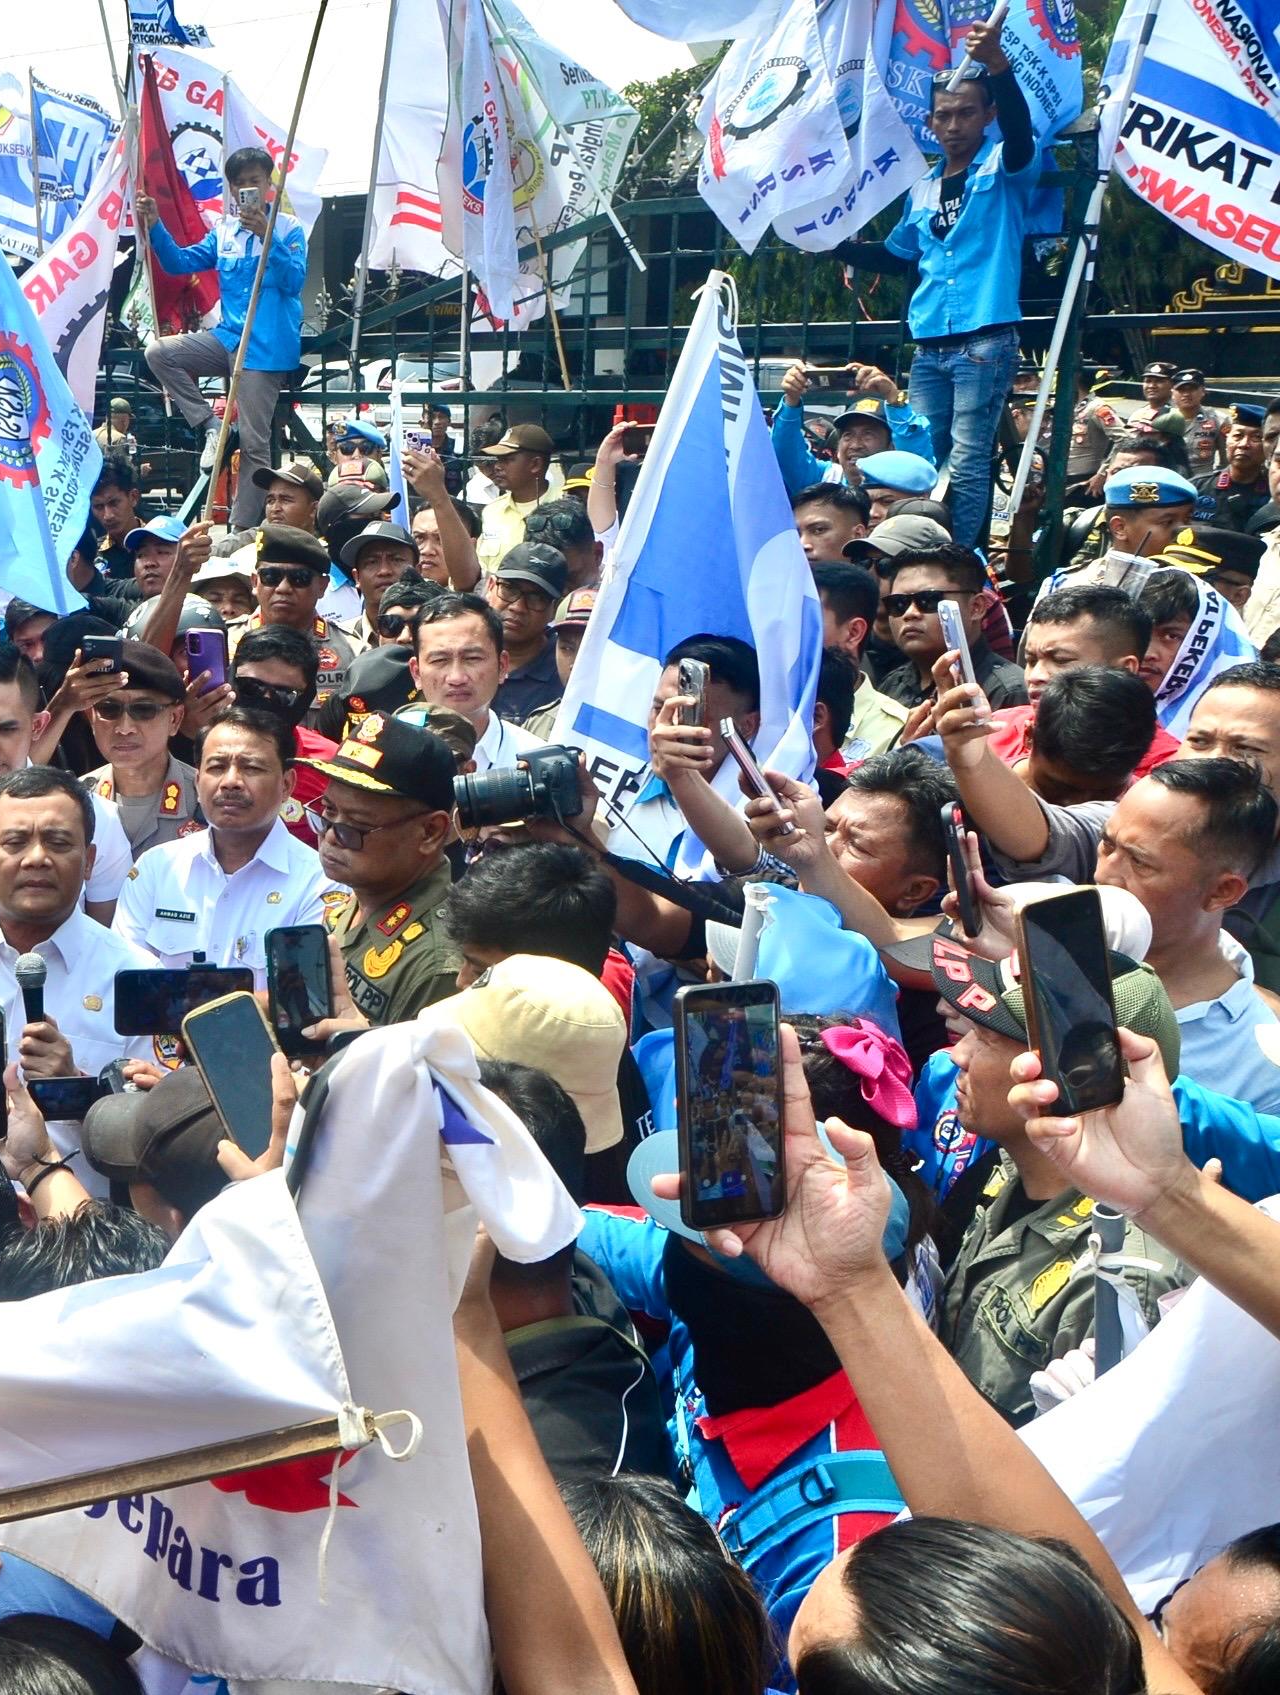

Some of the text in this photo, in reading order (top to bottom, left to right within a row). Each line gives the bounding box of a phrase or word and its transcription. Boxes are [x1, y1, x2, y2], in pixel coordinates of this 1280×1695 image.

[1193, 0, 1241, 60] ONESIA
[1240, 67, 1271, 107] PATI
[1021, 68, 1059, 123] INDONESI
[1120, 101, 1274, 191] RIKAT
[317, 673, 344, 684] OLR
